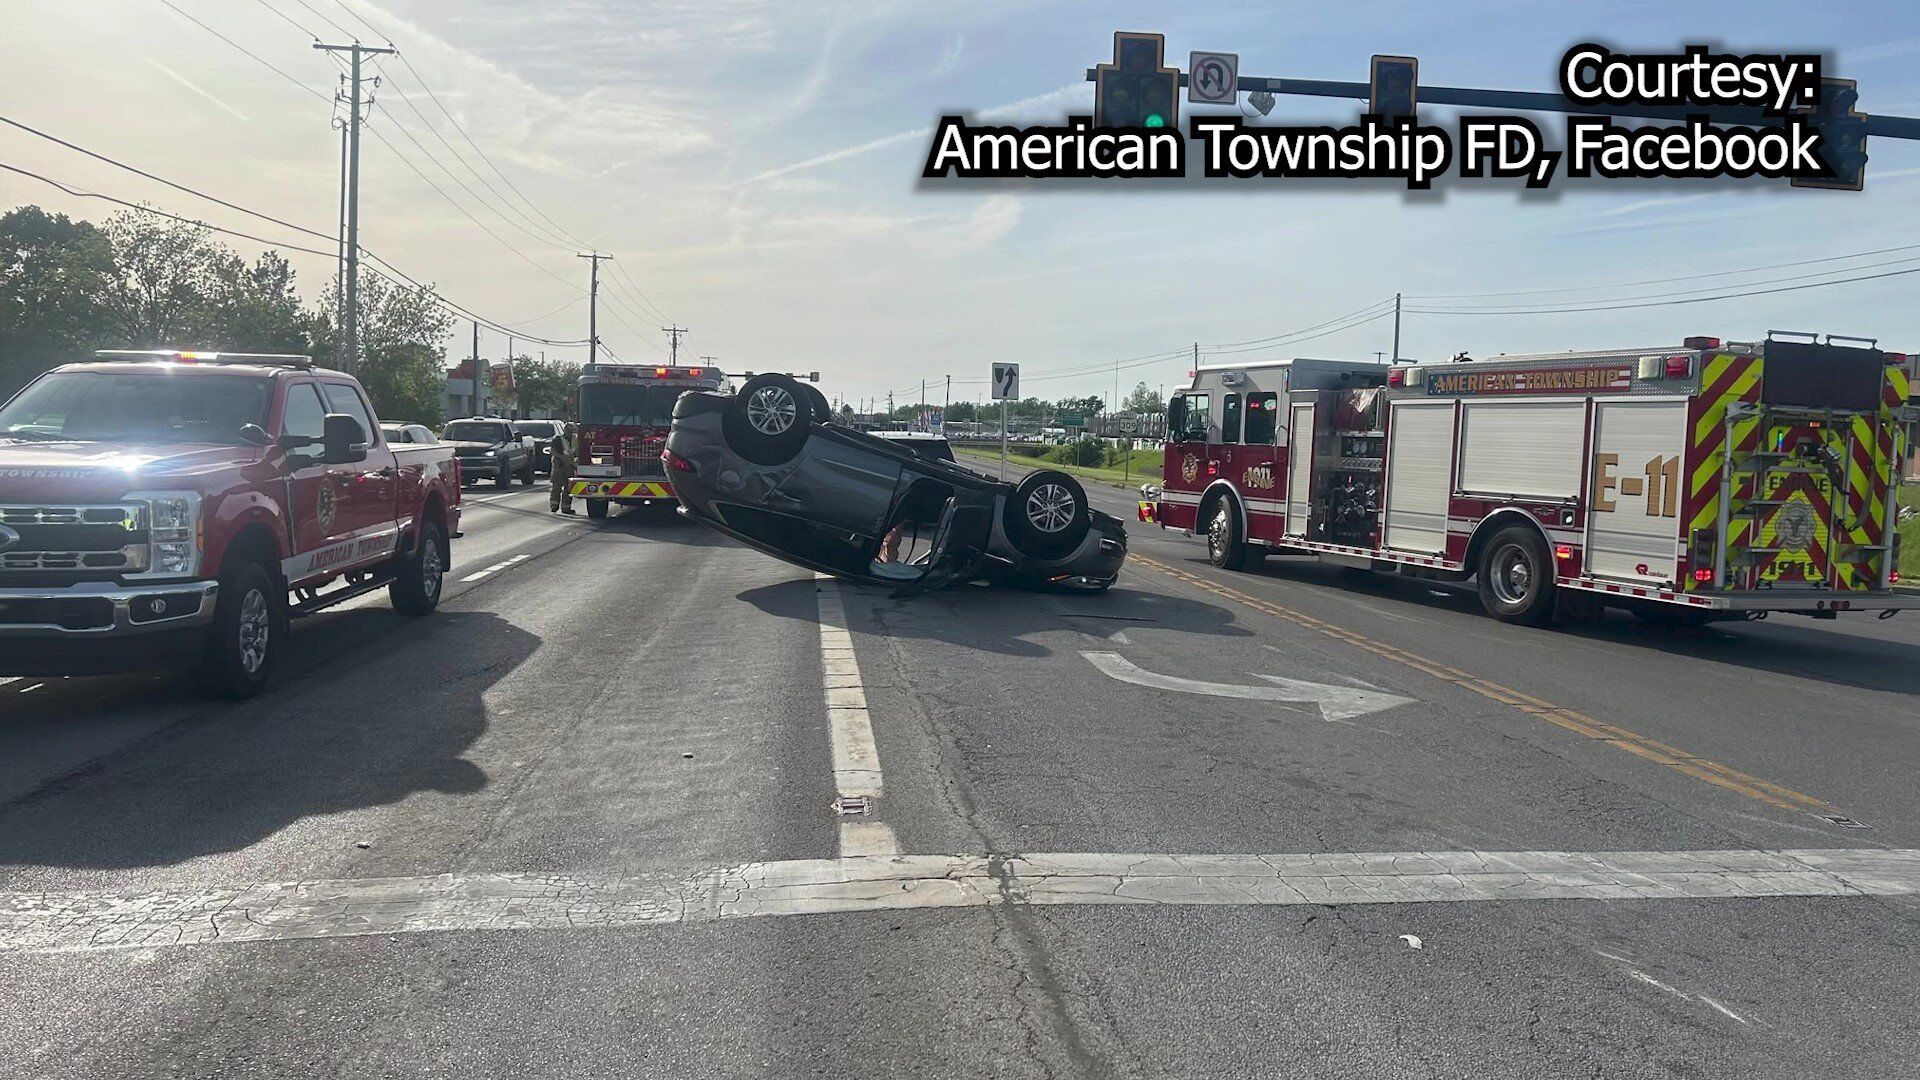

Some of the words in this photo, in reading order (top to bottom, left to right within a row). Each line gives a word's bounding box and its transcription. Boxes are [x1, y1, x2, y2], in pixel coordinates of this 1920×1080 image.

[1435, 373, 1516, 392] AMERICAN
[1522, 369, 1619, 389] TOWNSHIP
[1592, 453, 1680, 518] E-11
[307, 543, 354, 572] AMERICAN
